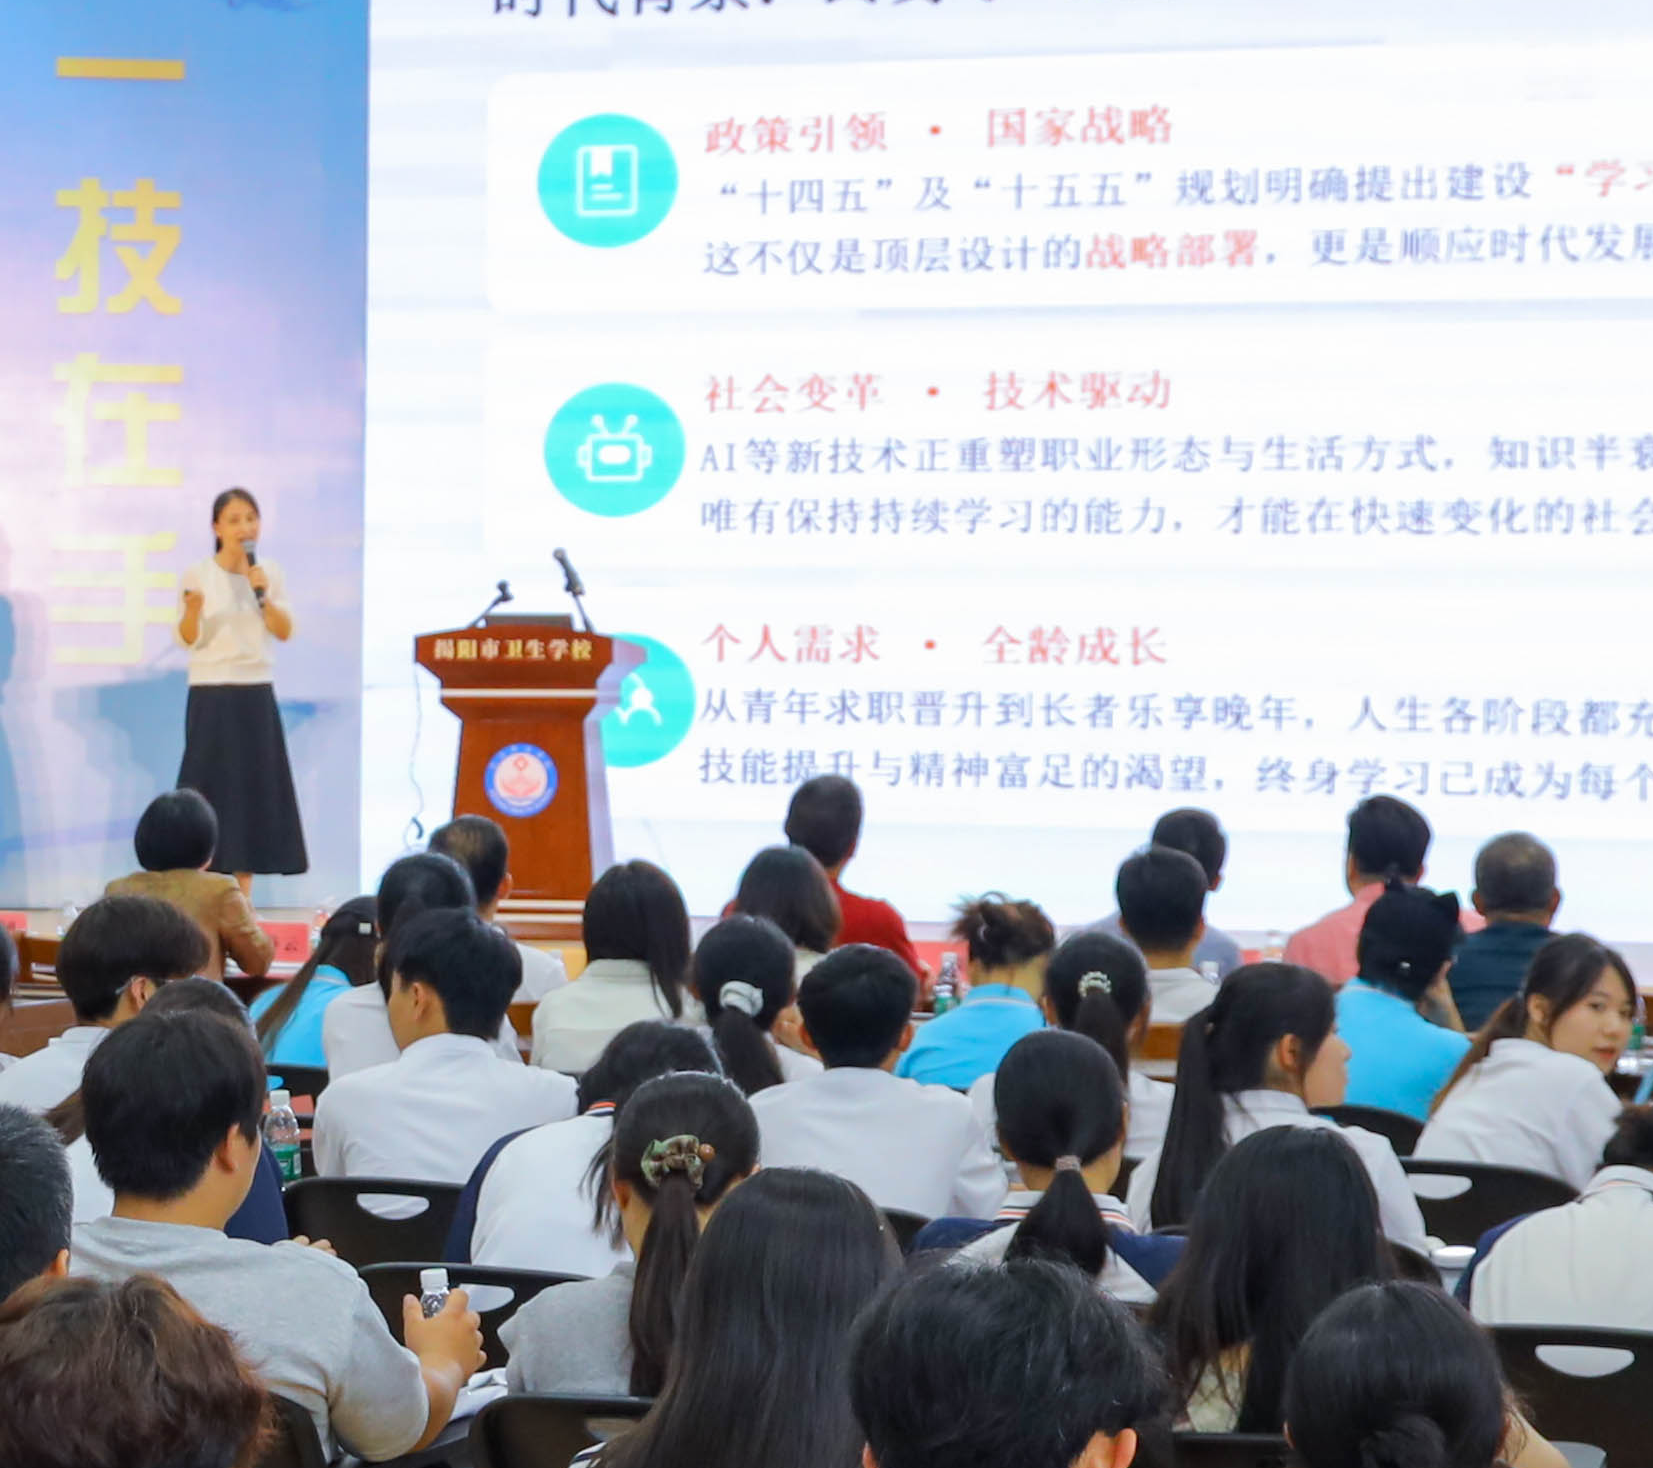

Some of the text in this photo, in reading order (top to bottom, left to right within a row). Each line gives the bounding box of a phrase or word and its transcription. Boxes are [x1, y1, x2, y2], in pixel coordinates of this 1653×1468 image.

[704, 113, 888, 154] 政策引领
[986, 104, 1172, 148] 国家战略
[51, 56, 185, 667] 一技在手
[704, 373, 885, 415] 社会变革
[983, 370, 1172, 412] 技术驱动
[433, 638, 593, 661] 揭阳市卫生学校
[705, 623, 882, 664] 个人需求
[984, 625, 1168, 667] 全龄成长
